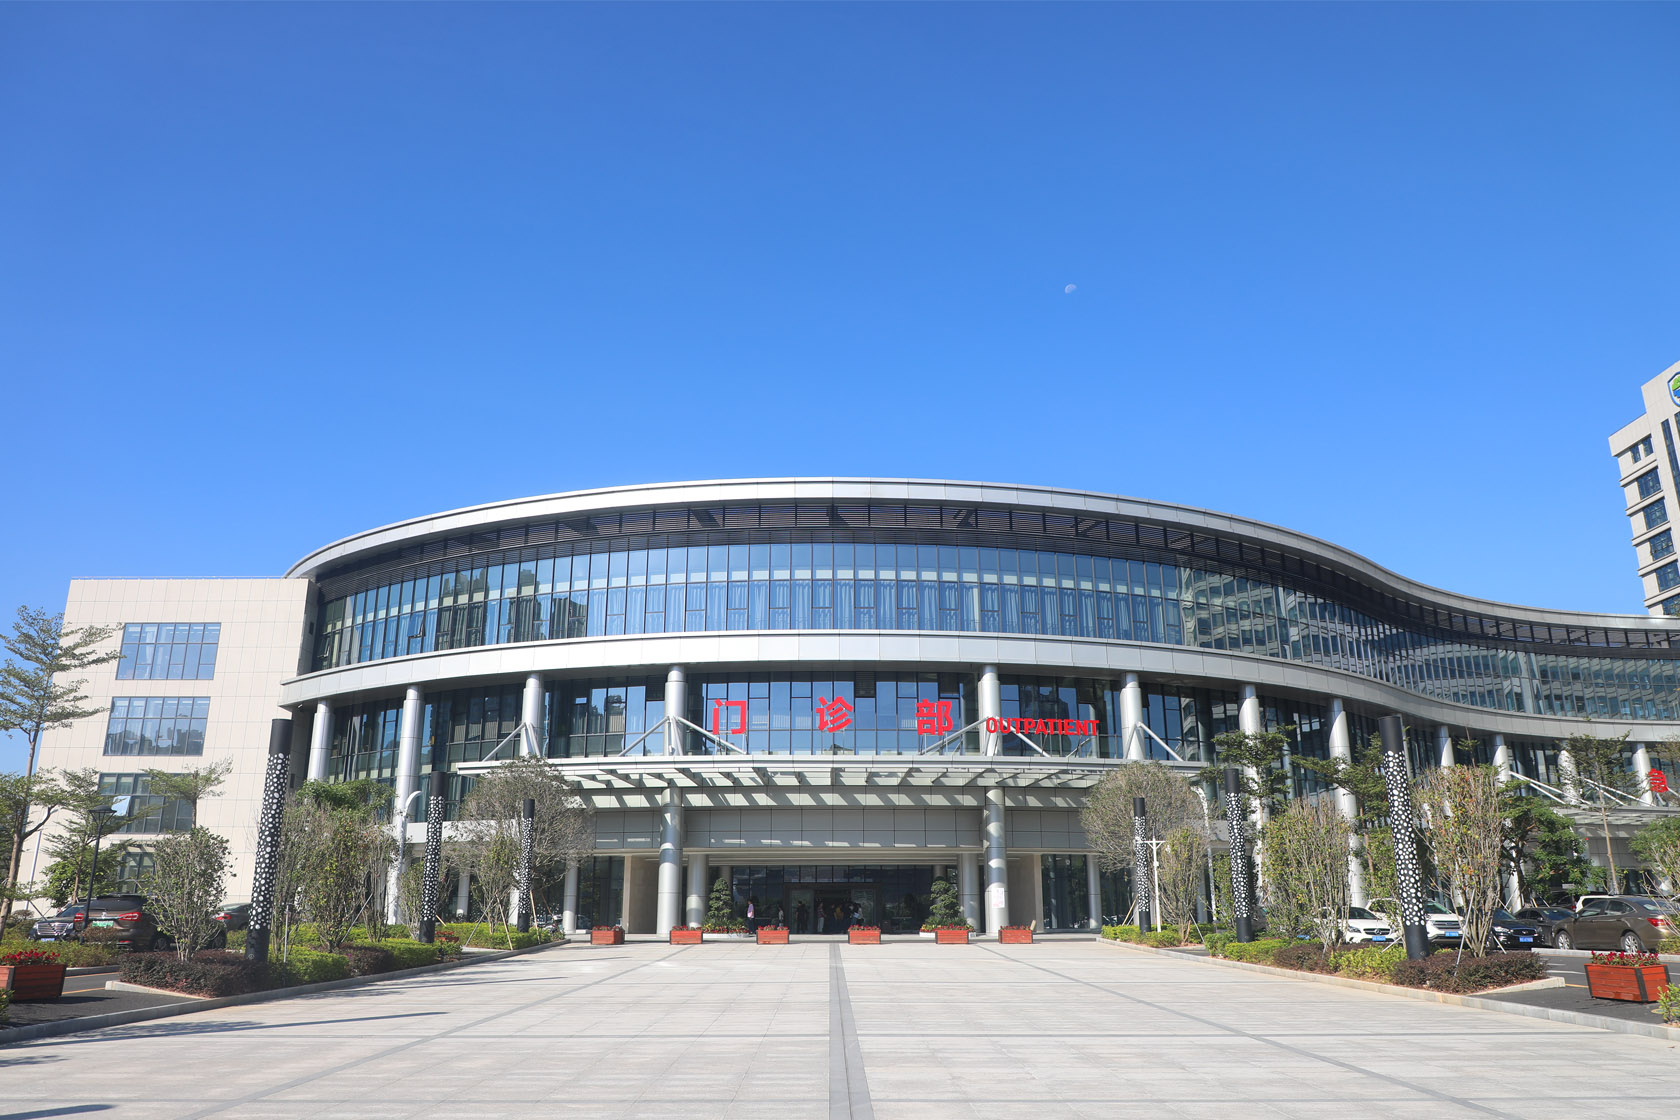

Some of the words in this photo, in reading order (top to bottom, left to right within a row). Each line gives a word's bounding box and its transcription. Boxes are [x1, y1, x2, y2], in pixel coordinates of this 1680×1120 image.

[712, 696, 954, 736] 门诊部
[986, 717, 1100, 737] OUTPATIENT
